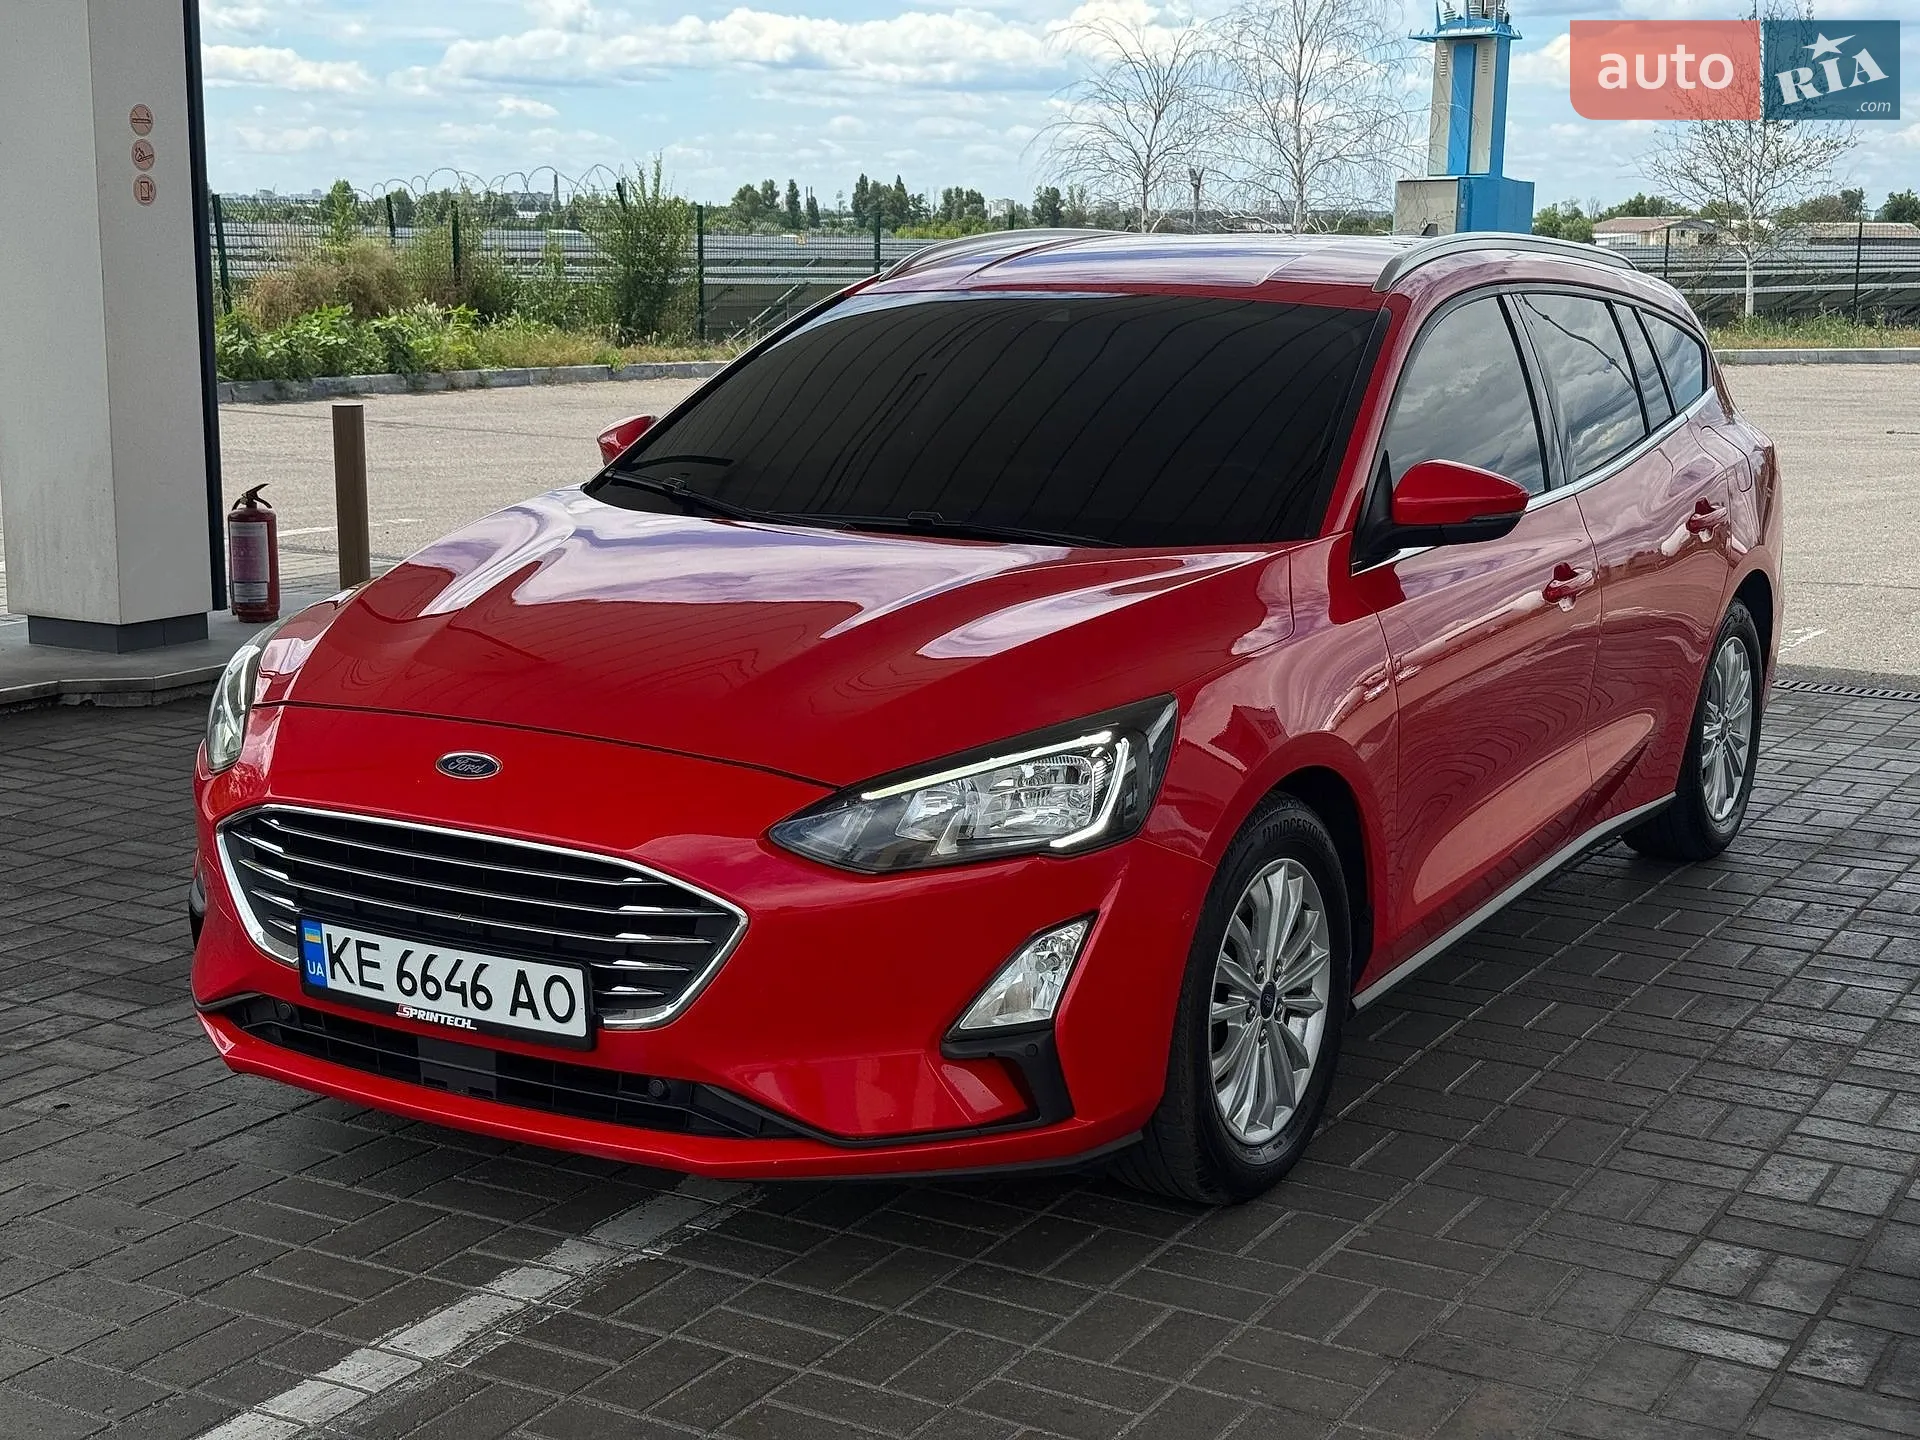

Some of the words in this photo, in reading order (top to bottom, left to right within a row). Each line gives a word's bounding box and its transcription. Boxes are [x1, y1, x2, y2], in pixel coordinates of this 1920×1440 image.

[448, 756, 487, 773] Ford
[307, 959, 325, 978] UA
[325, 933, 385, 992] KE
[396, 949, 494, 1011] 6646
[508, 968, 577, 1024] AO
[396, 1002, 478, 1031] SPRINTECH
